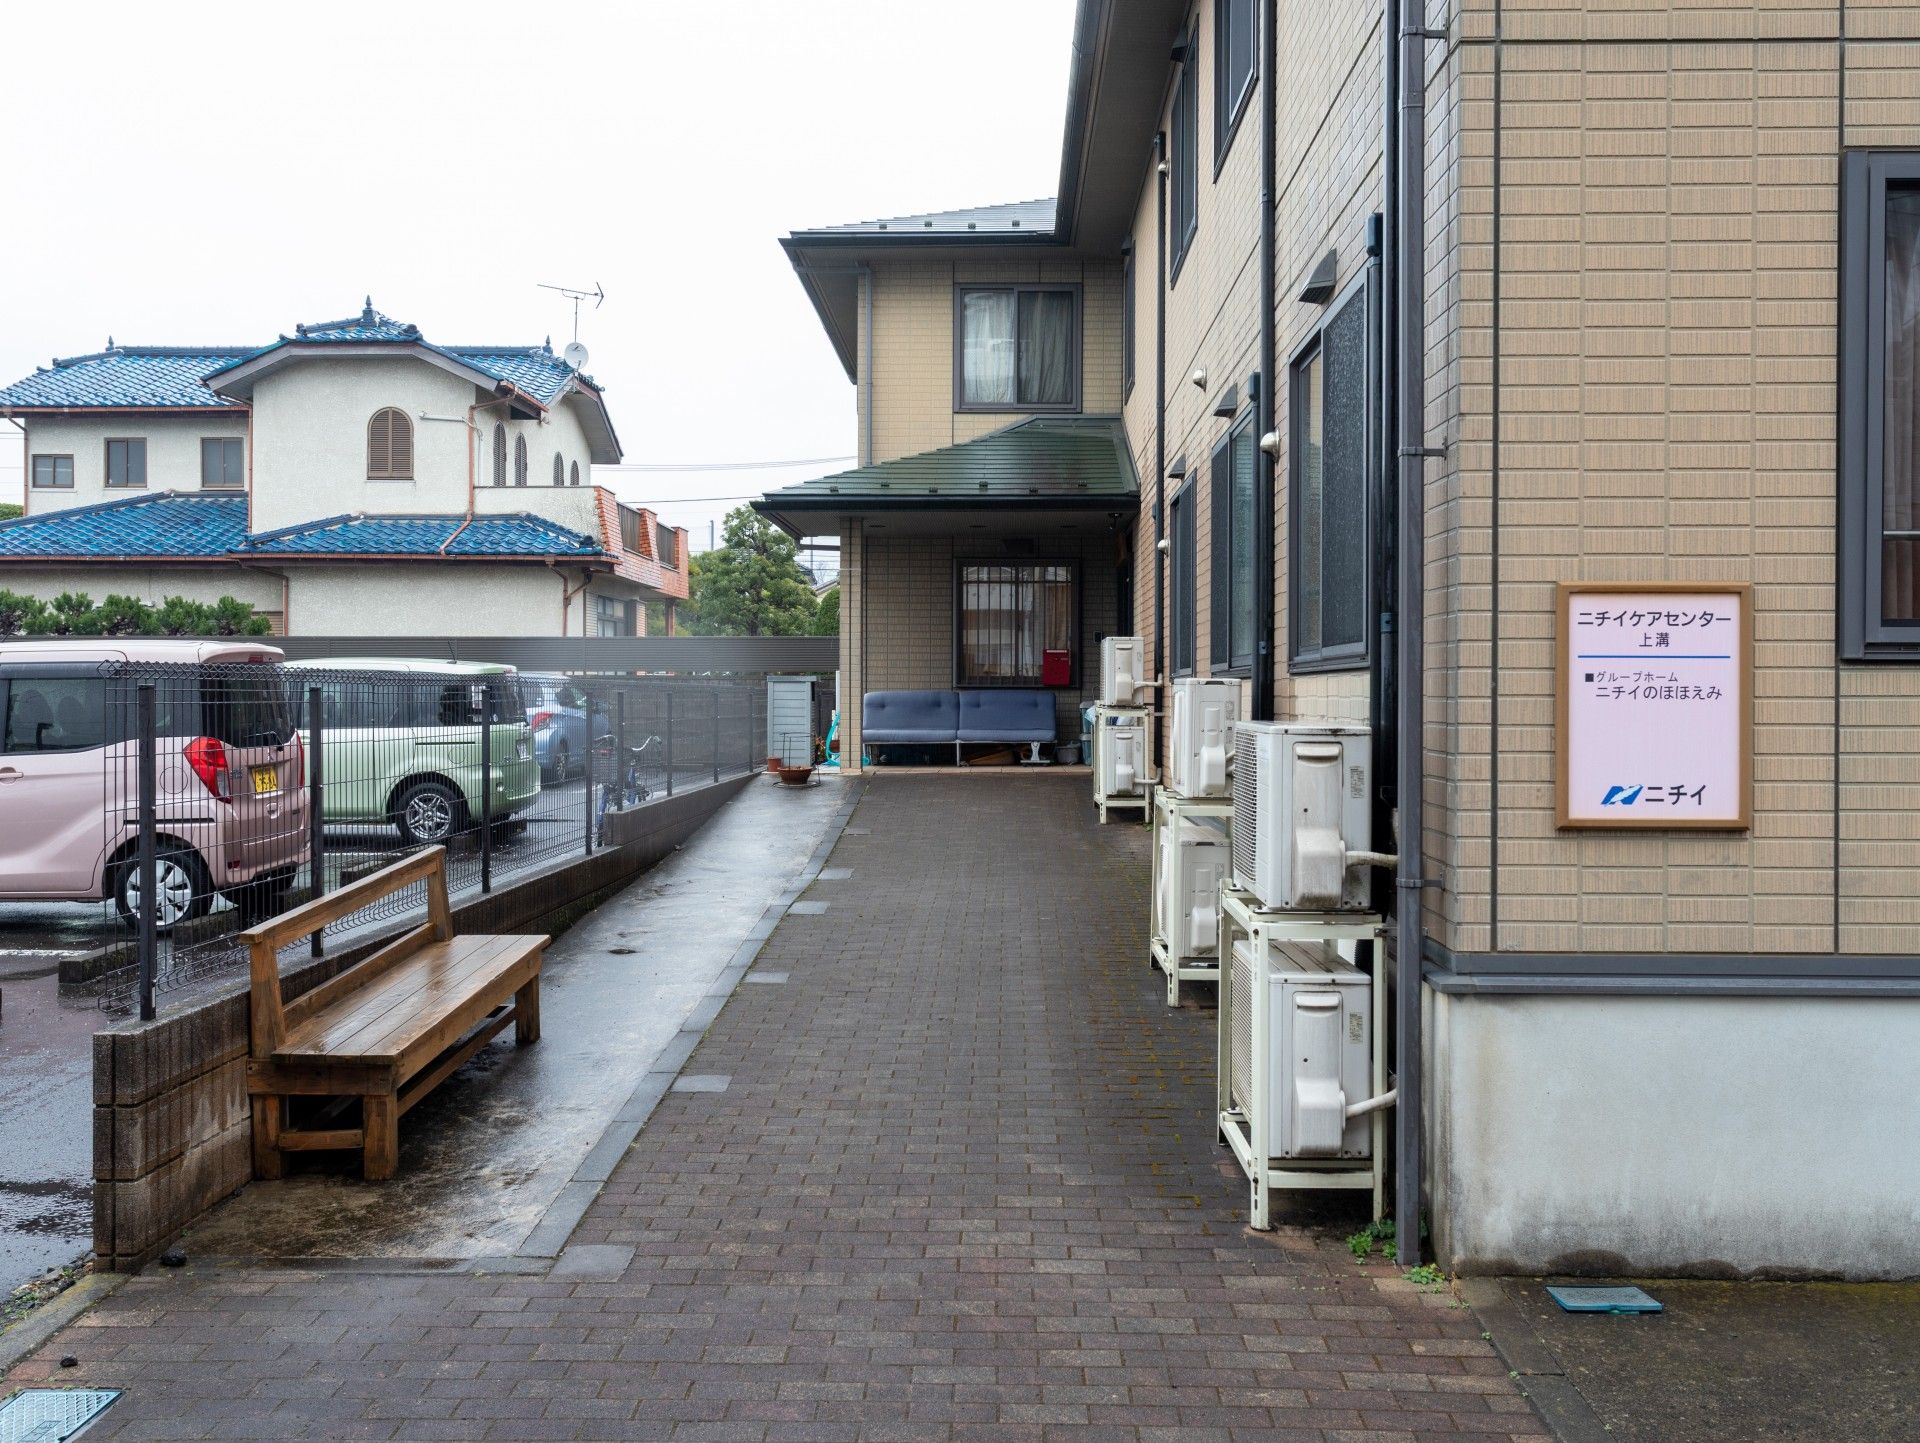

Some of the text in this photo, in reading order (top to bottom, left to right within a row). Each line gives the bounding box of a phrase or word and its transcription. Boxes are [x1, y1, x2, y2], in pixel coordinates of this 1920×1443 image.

[1578, 611, 1731, 627] ニチイケアセンター
[1639, 632, 1670, 648] 上溝
[1596, 685, 1722, 699] ニチイのほほえみ
[1645, 784, 1707, 806] ニチイ
